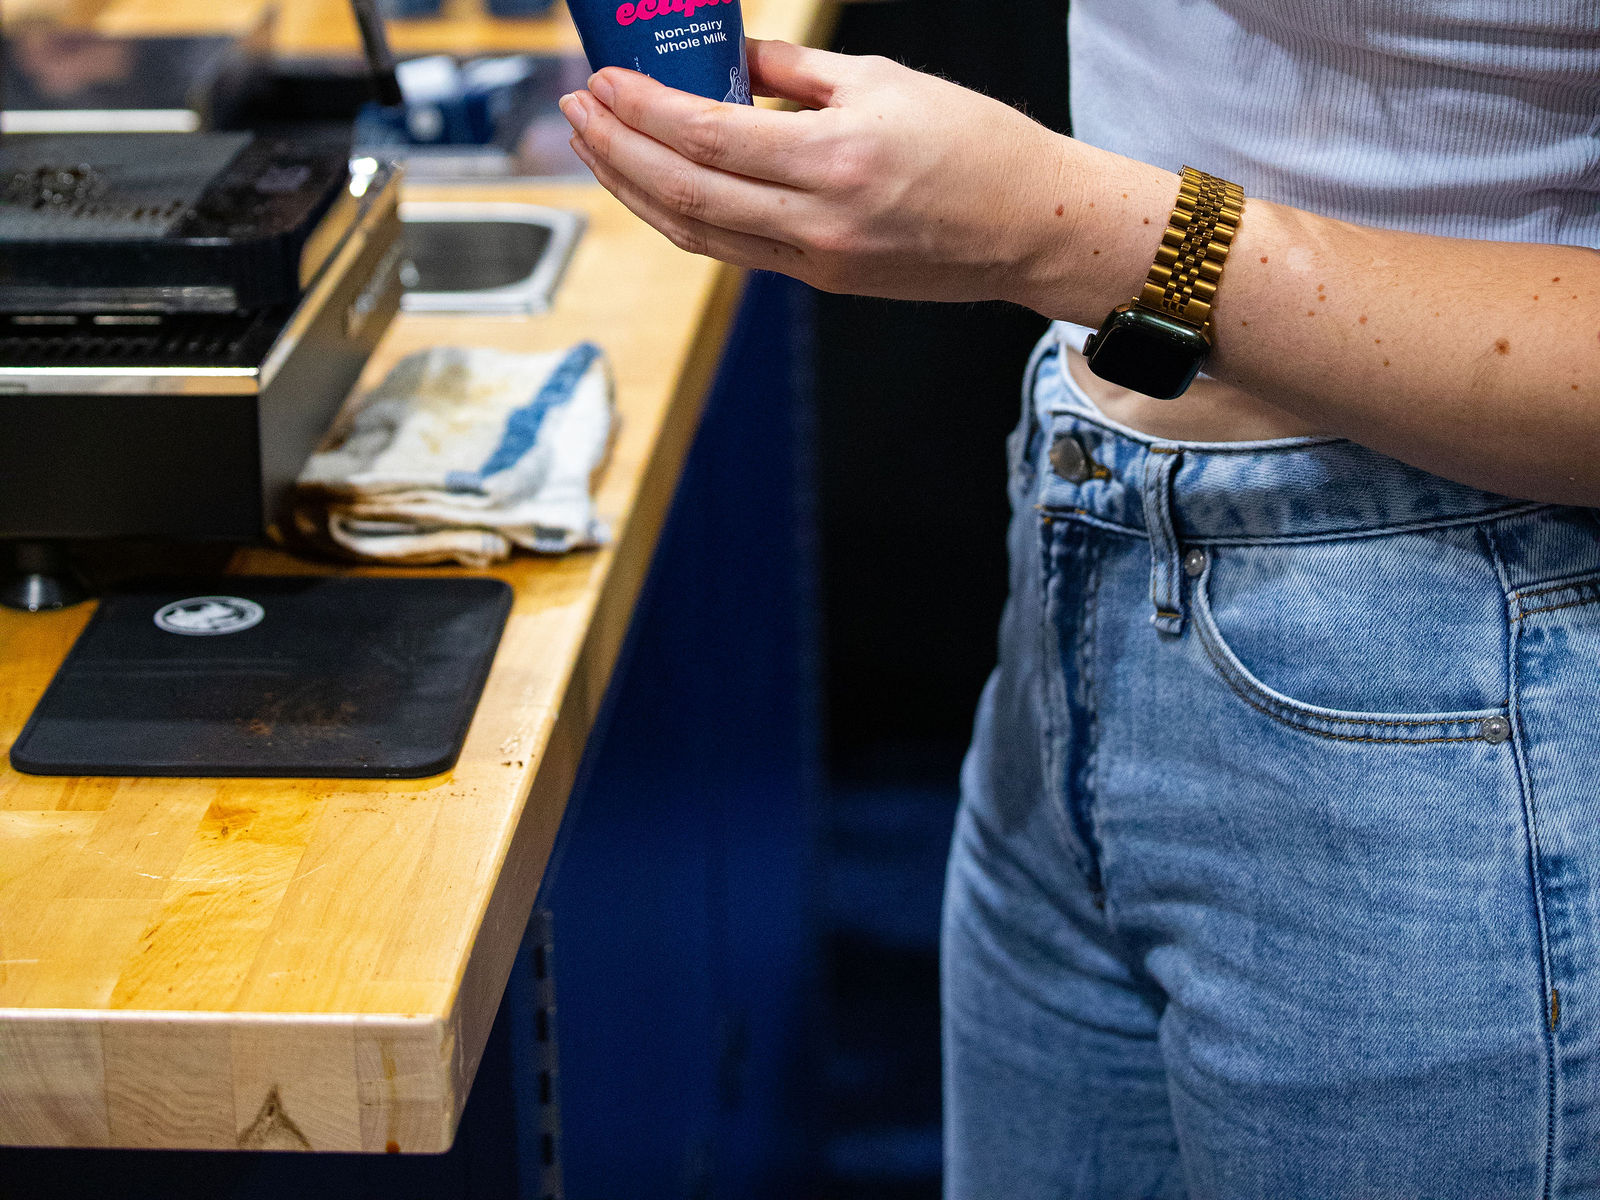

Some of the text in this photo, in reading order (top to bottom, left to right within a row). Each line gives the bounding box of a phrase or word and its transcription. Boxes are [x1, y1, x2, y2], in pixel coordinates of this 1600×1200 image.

[654, 20, 722, 41] Non-Dairy
[655, 32, 727, 55] Whole Milk
